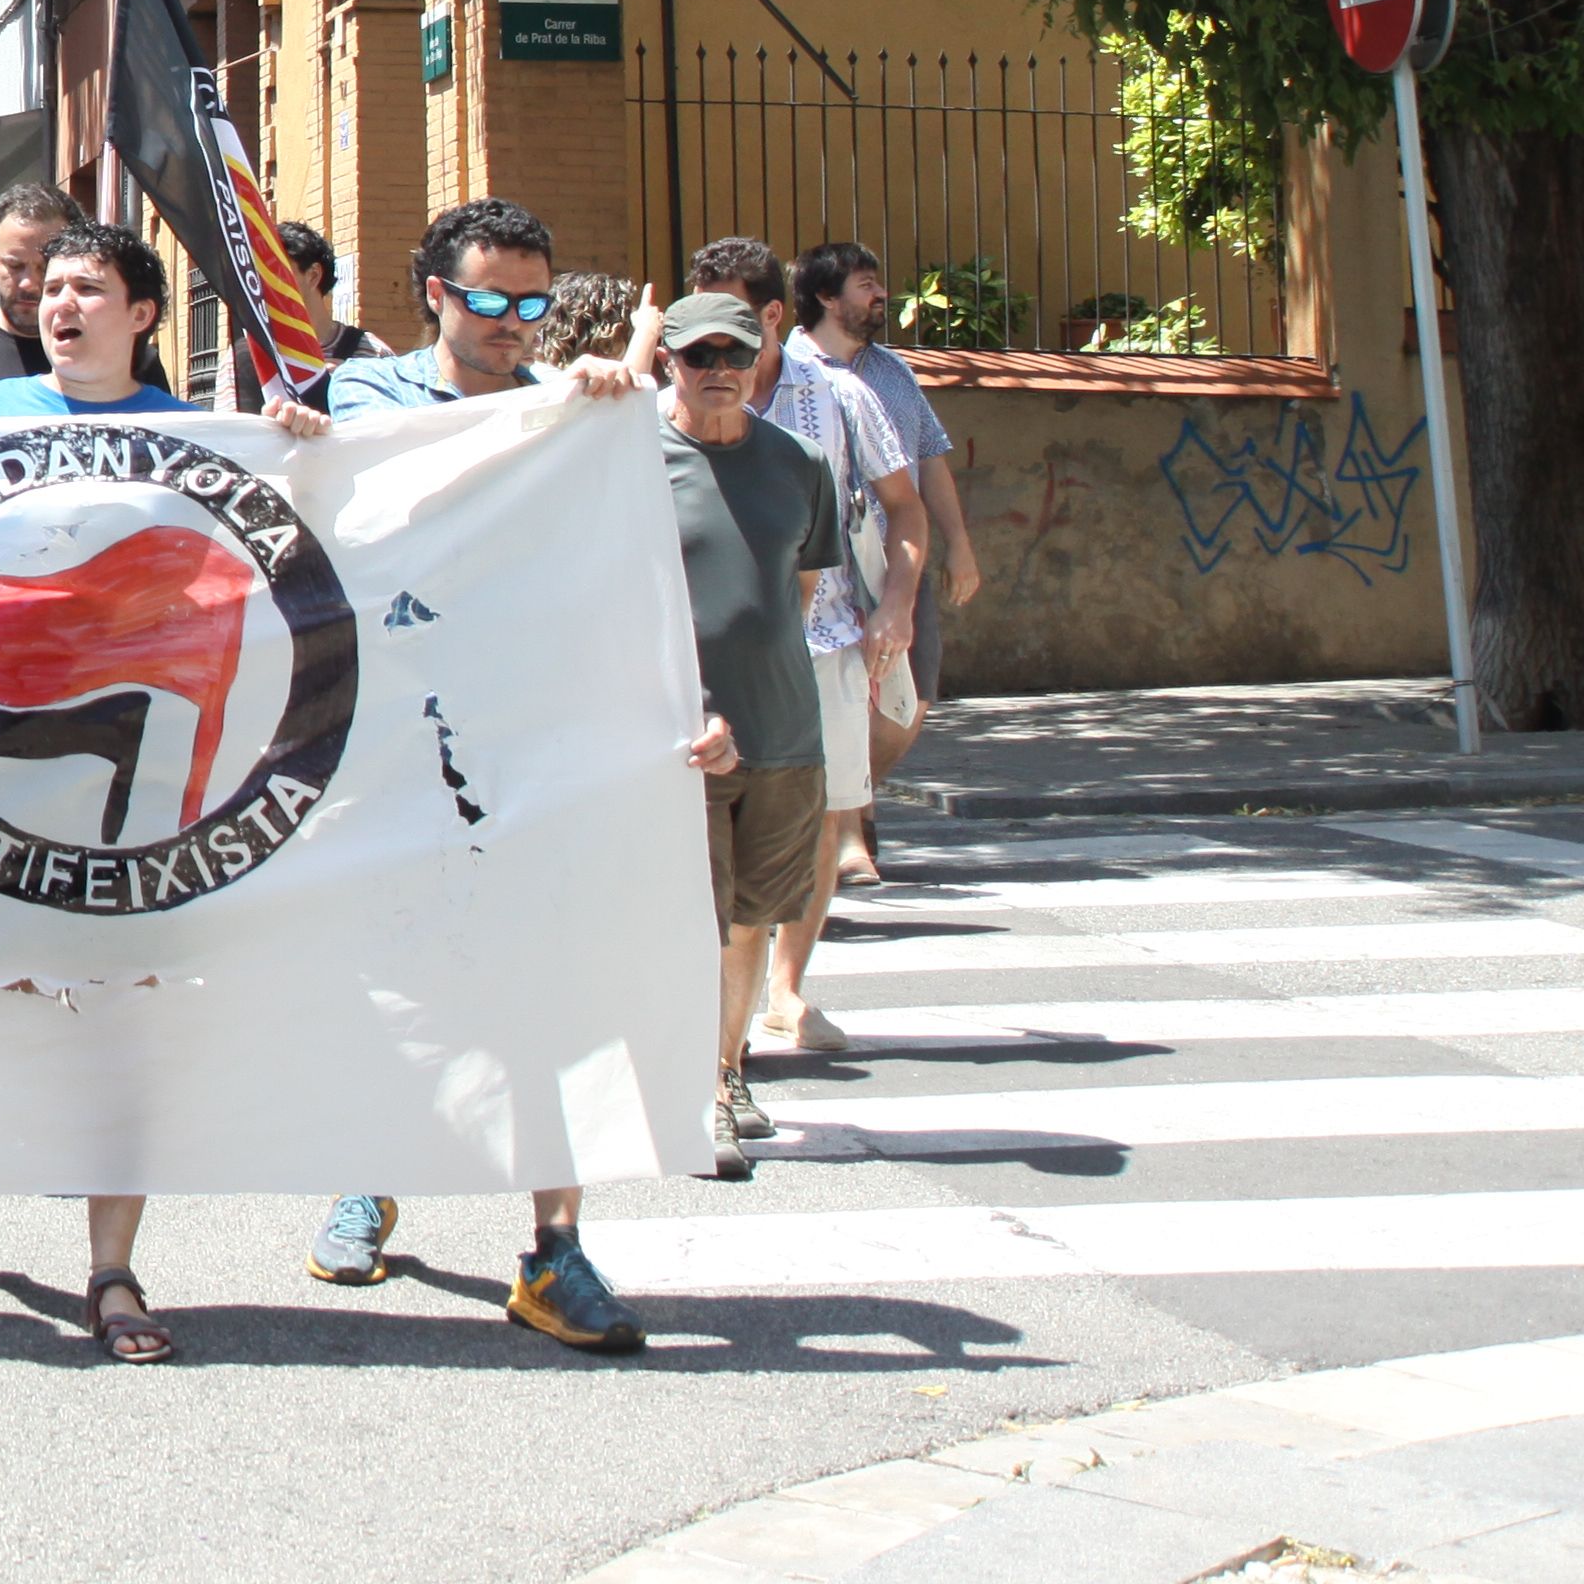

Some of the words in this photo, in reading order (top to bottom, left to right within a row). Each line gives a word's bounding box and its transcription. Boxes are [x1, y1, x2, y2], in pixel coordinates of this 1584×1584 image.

[544, 18, 576, 30] Carrer
[515, 33, 528, 44] de
[531, 33, 552, 44] Prat
[555, 33, 567, 44] de
[571, 33, 580, 44] la
[583, 34, 607, 45] Riba
